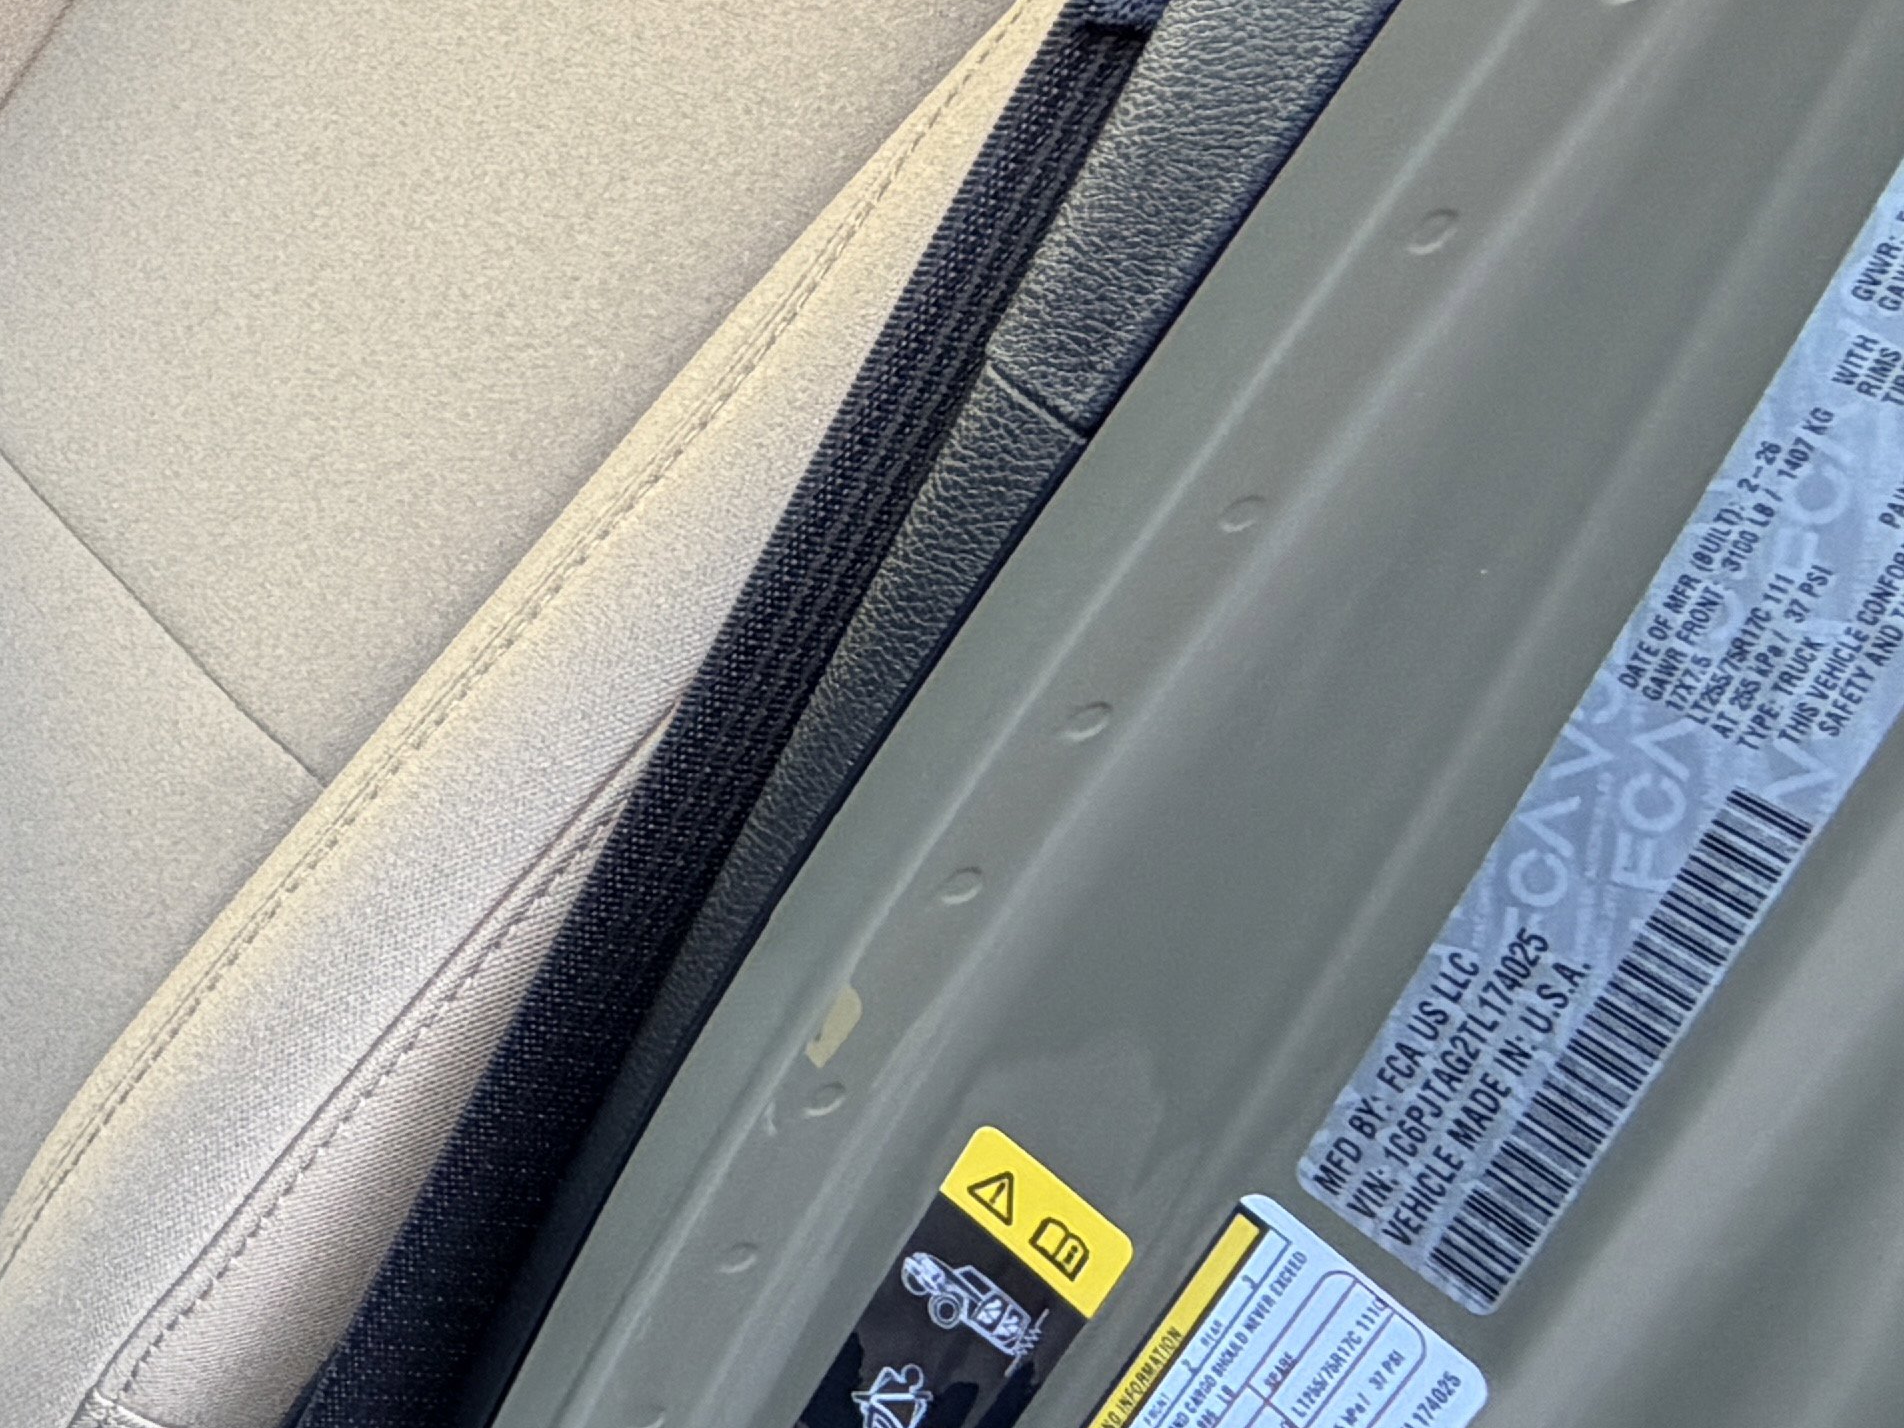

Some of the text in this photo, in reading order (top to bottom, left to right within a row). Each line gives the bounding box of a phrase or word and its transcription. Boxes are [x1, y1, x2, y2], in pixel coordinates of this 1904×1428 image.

[1829, 328, 1882, 393] WITH
[1853, 341, 1904, 403] RIMS
[1709, 708, 1742, 741] AT
[1797, 559, 1836, 600] PSI
[1734, 630, 1828, 757] TYPE: TRUCK
[1775, 696, 1823, 750] THIS
[1804, 622, 1871, 706] VEHICLE
[1814, 619, 1904, 741] SAFETY AND
[1311, 946, 1482, 1198] MFD BY: FCA US LLC
[1345, 921, 1553, 1225] VIN: 1C6PJTAG2TL174025
[1382, 945, 1593, 1249] VEHICLE MADE IN: U.S.A.
[1113, 1323, 1185, 1417] INFORMATION
